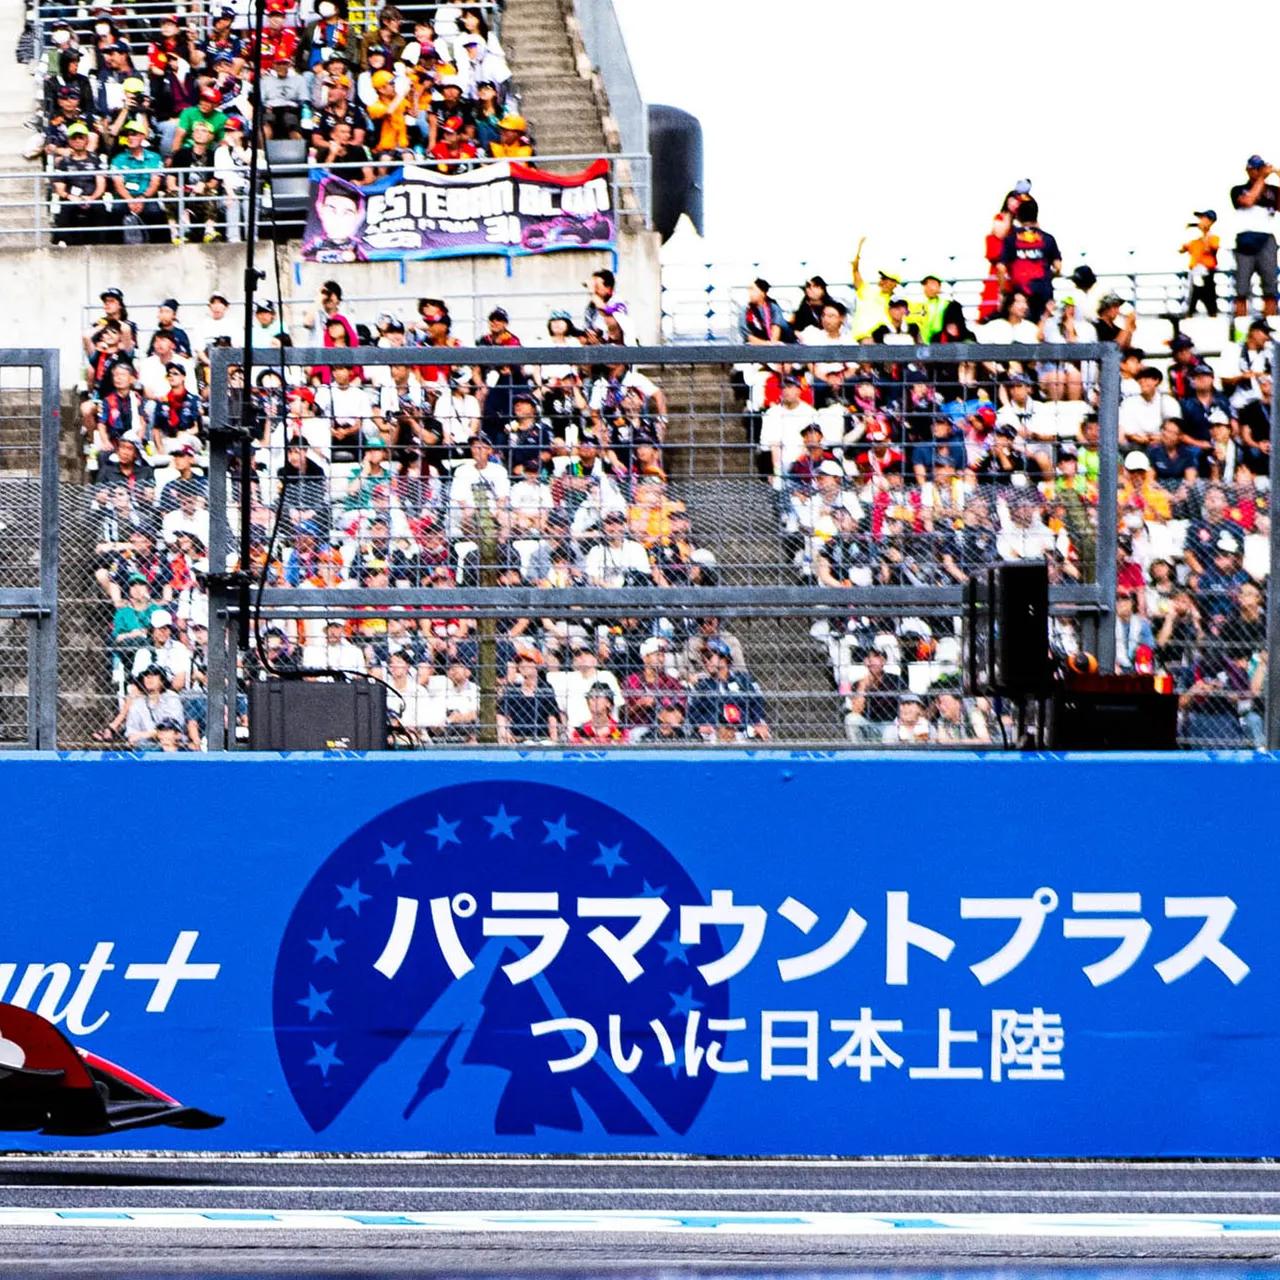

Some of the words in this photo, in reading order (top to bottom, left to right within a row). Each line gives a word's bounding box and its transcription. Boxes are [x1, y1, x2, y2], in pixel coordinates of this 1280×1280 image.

[374, 887, 1250, 987] パラマウントプラス
[531, 1008, 1065, 1081] ついに日本上陸
